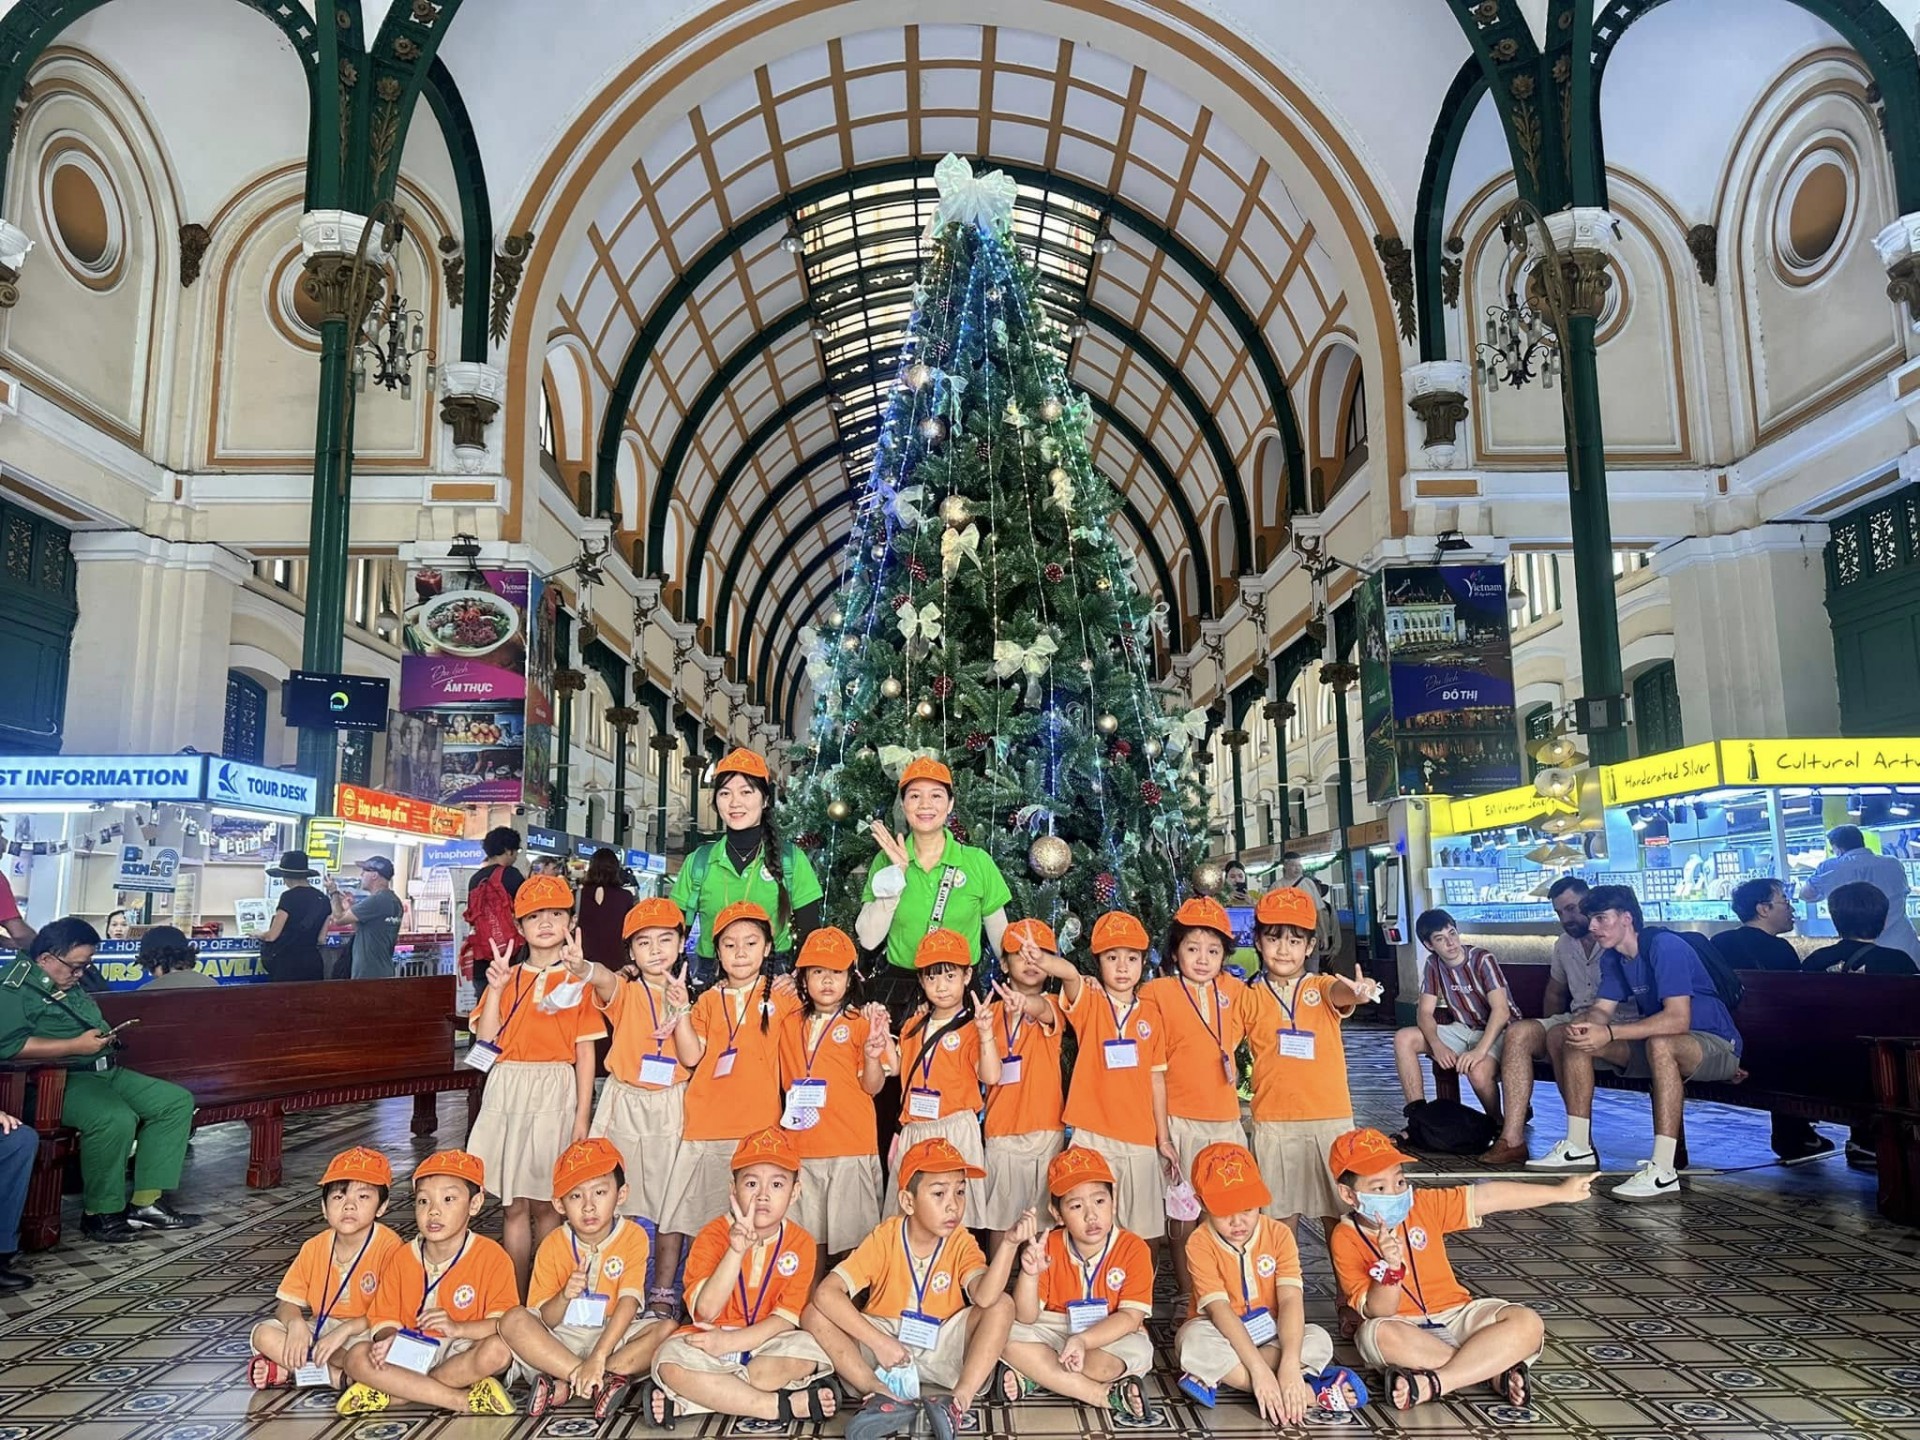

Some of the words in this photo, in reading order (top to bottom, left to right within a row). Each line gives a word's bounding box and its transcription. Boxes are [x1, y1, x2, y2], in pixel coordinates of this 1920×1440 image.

[1462, 578, 1502, 598] Vietnam
[1442, 688, 1459, 700] ĐÔ
[1460, 690, 1478, 702] THỊ
[1776, 750, 1859, 770] Cultural
[26, 768, 188, 786] INFORMATION
[247, 777, 279, 797] TOUR
[281, 783, 308, 802] DESK
[428, 849, 482, 860] vinaphone
[150, 860, 173, 877] 5G
[210, 940, 233, 950] OFF
